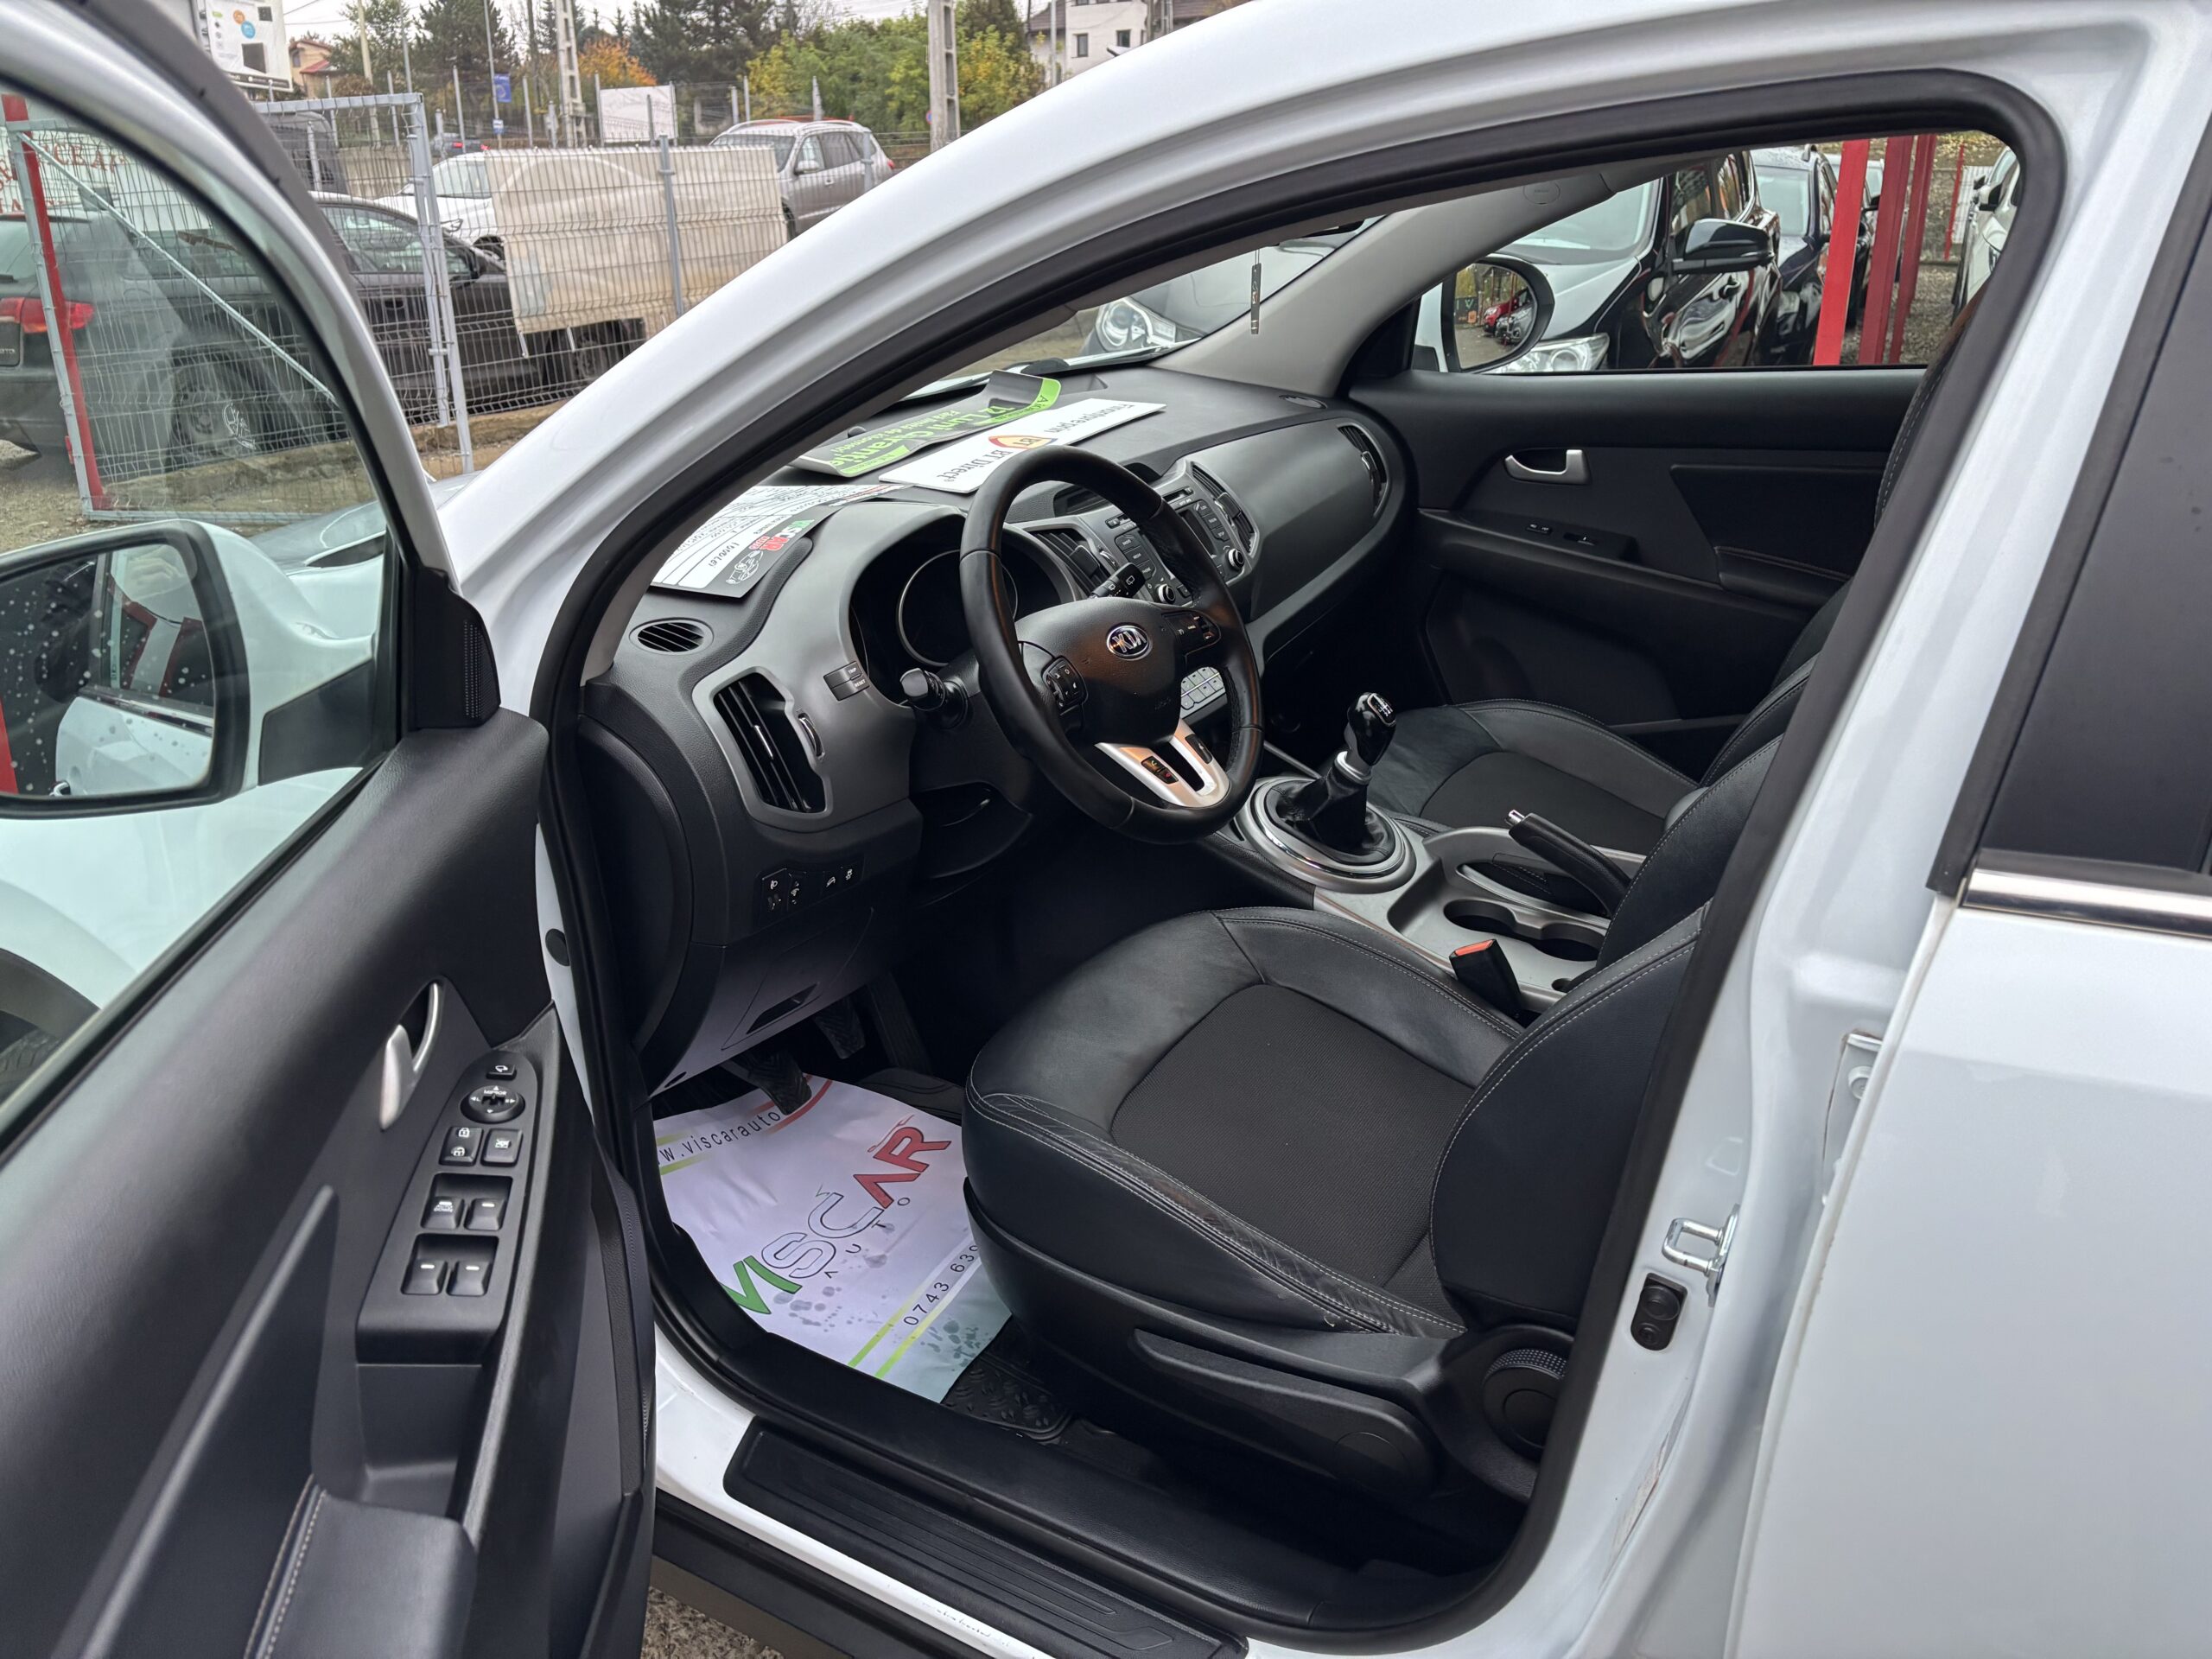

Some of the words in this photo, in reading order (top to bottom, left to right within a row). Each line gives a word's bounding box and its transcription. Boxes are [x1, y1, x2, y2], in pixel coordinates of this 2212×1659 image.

[926, 413, 991, 430] Luni
[1012, 438, 1041, 447] BT
[982, 449, 1014, 460] BT
[1112, 629, 1147, 653] KIA
[854, 678, 866, 688] RESET
[903, 1281, 950, 1326] 0743
